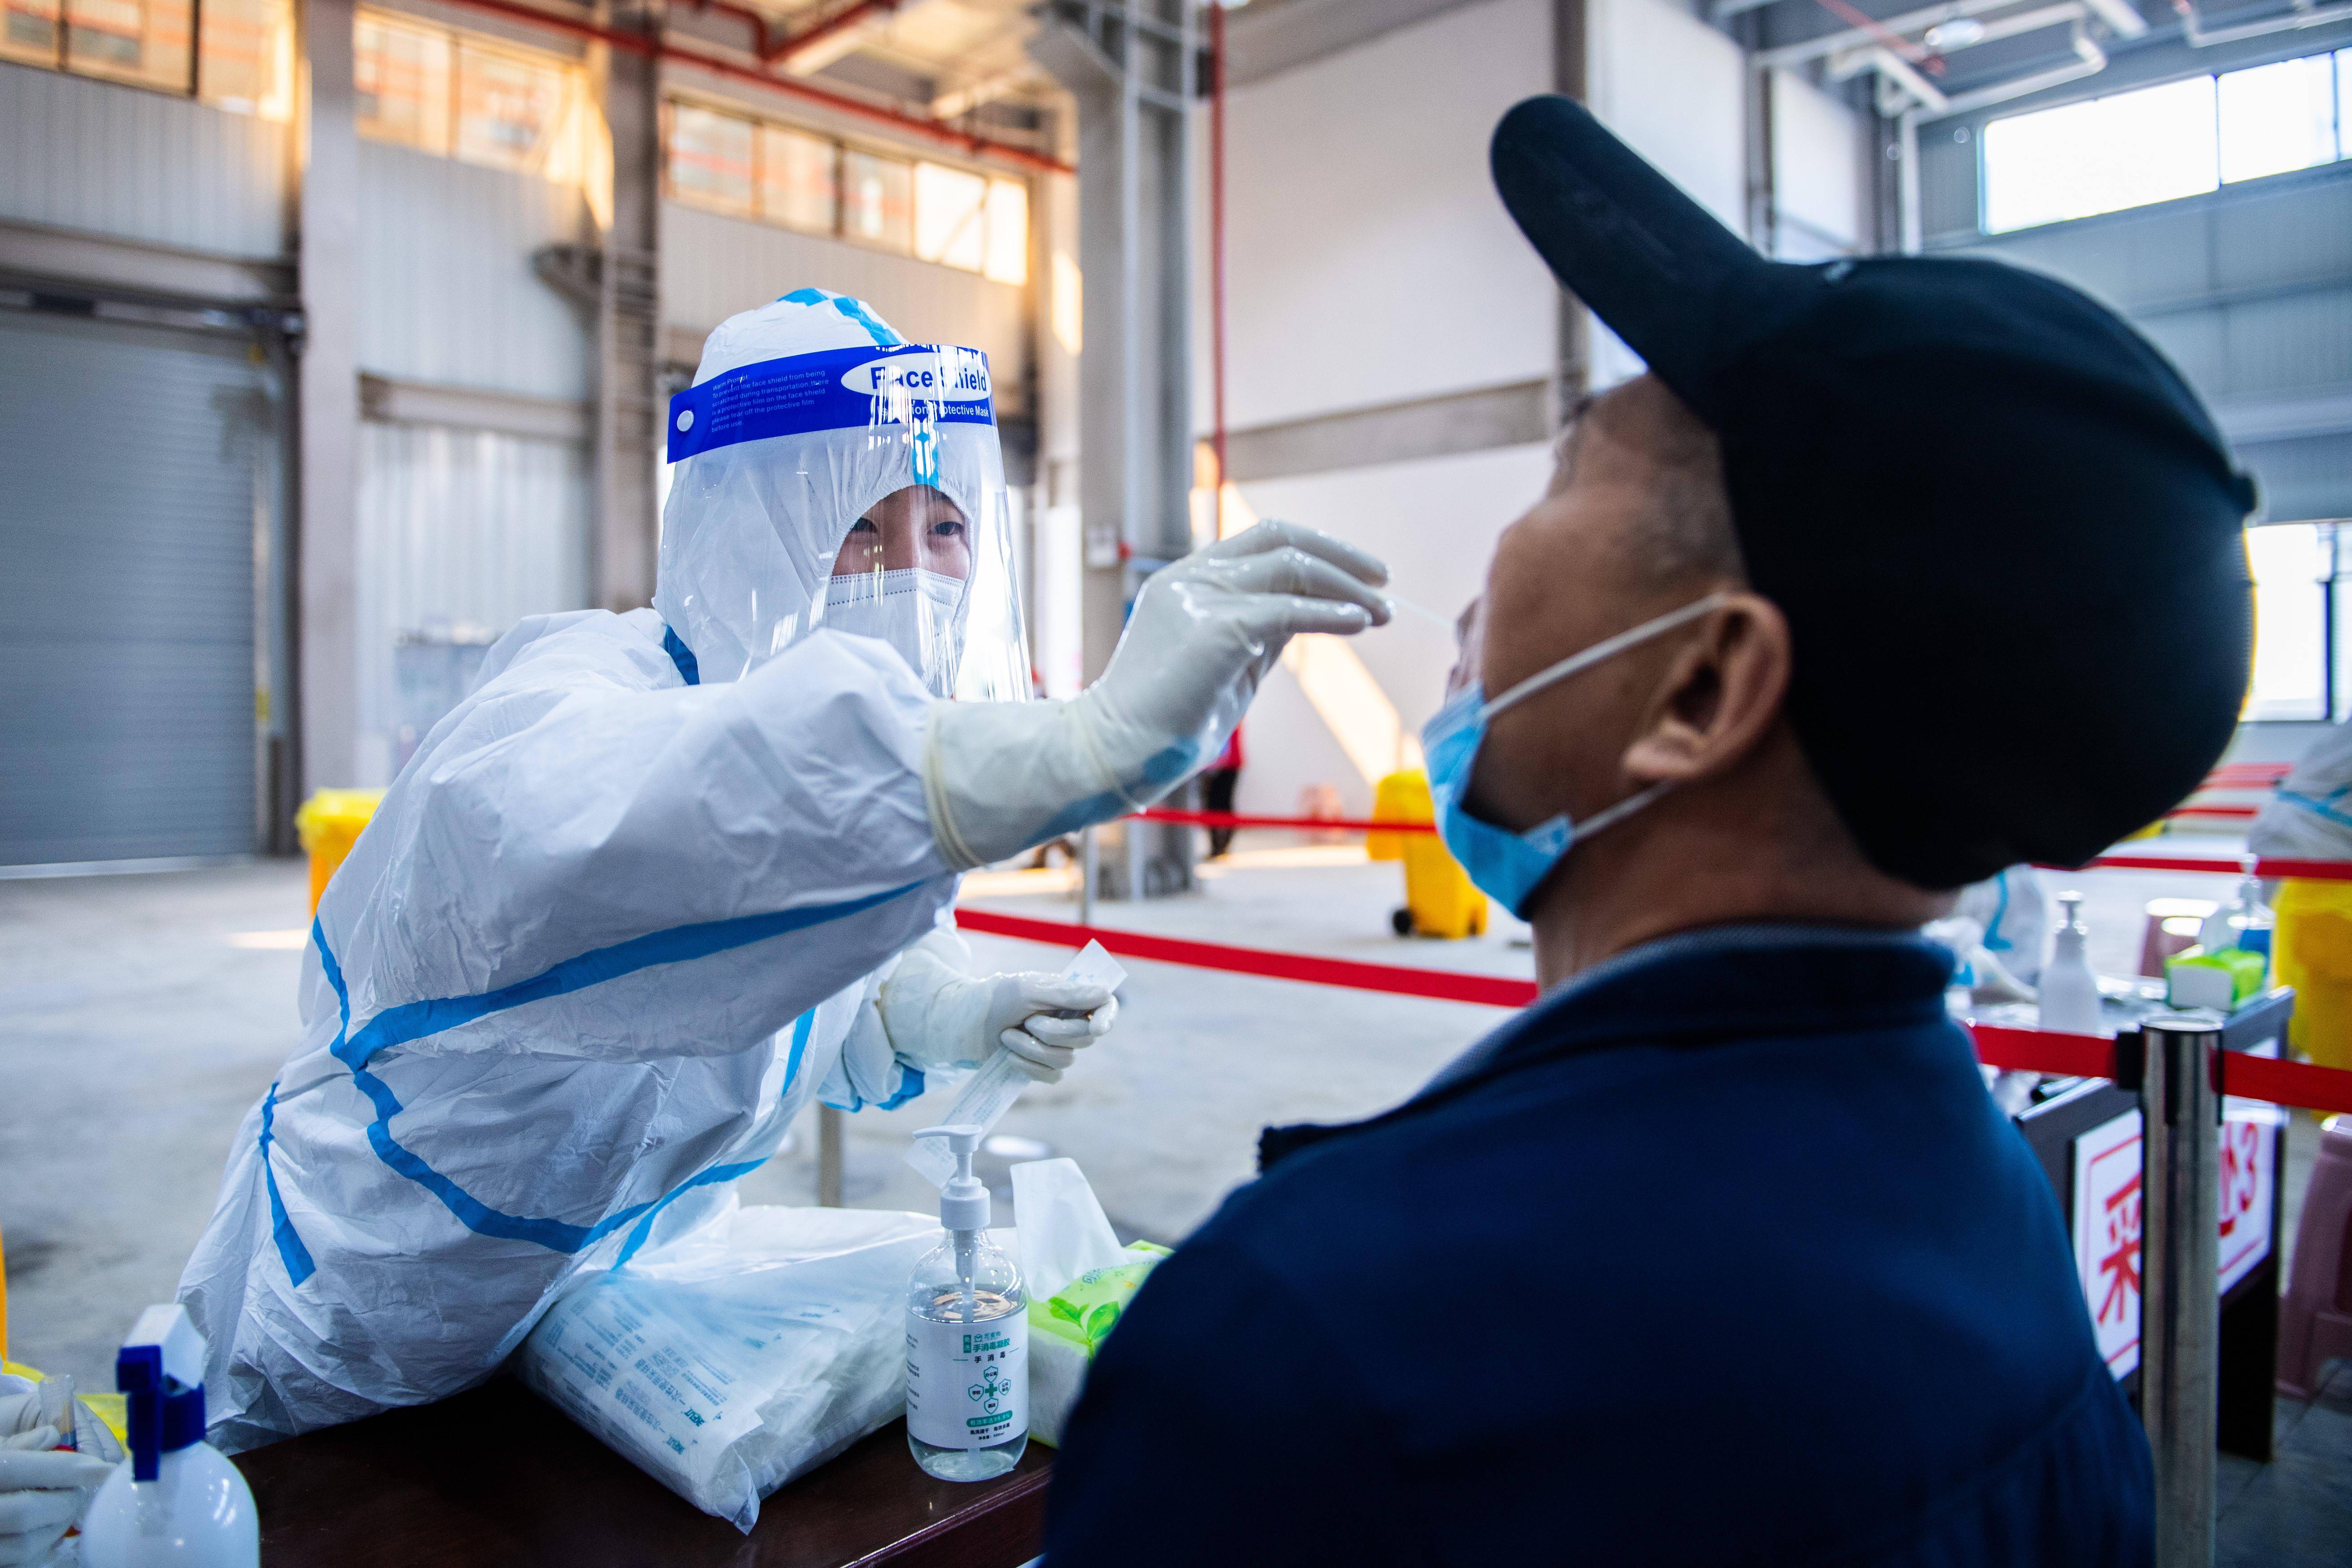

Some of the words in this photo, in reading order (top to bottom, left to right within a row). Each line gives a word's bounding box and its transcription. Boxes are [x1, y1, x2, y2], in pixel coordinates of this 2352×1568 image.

[713, 382, 727, 391] Warm
[719, 385, 740, 397] prevent
[768, 376, 787, 384] shield
[712, 394, 738, 408] scratched
[739, 391, 760, 399] during
[721, 401, 751, 414] protective
[804, 388, 825, 397] shield
[712, 414, 730, 426] please
[766, 401, 800, 413] protective
[975, 405, 989, 418] Mask
[712, 424, 730, 432] before
[973, 1338, 1010, 1353] 手消毒凝胶
